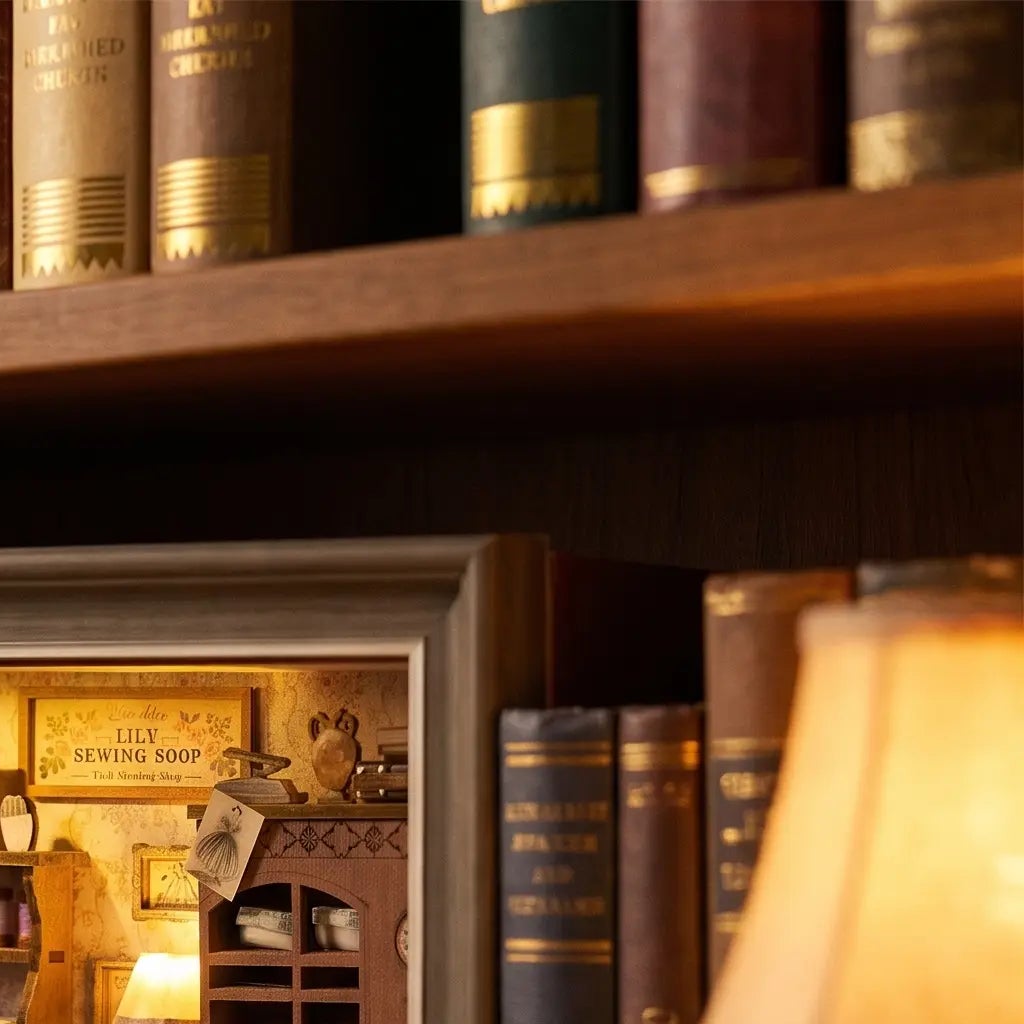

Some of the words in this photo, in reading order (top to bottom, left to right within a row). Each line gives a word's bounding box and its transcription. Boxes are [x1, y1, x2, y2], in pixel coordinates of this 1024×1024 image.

[116, 728, 158, 744] LILY
[74, 748, 147, 763] SEWING
[155, 748, 201, 763] SOOP
